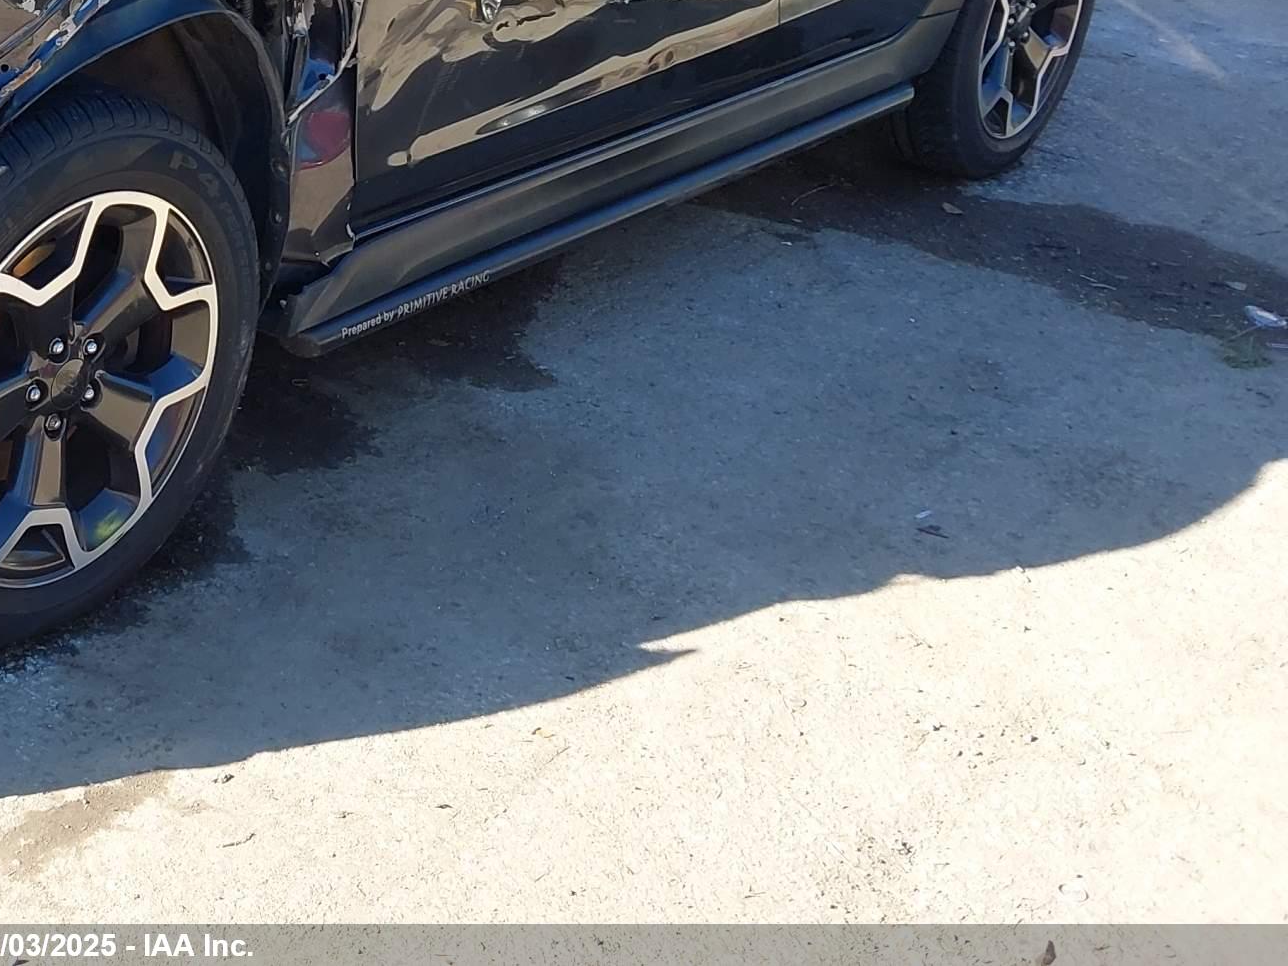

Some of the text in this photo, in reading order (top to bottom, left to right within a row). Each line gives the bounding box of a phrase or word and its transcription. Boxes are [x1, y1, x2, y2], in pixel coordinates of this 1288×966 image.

[340, 269, 491, 339] Prepared by PRIMITIVE RACING
